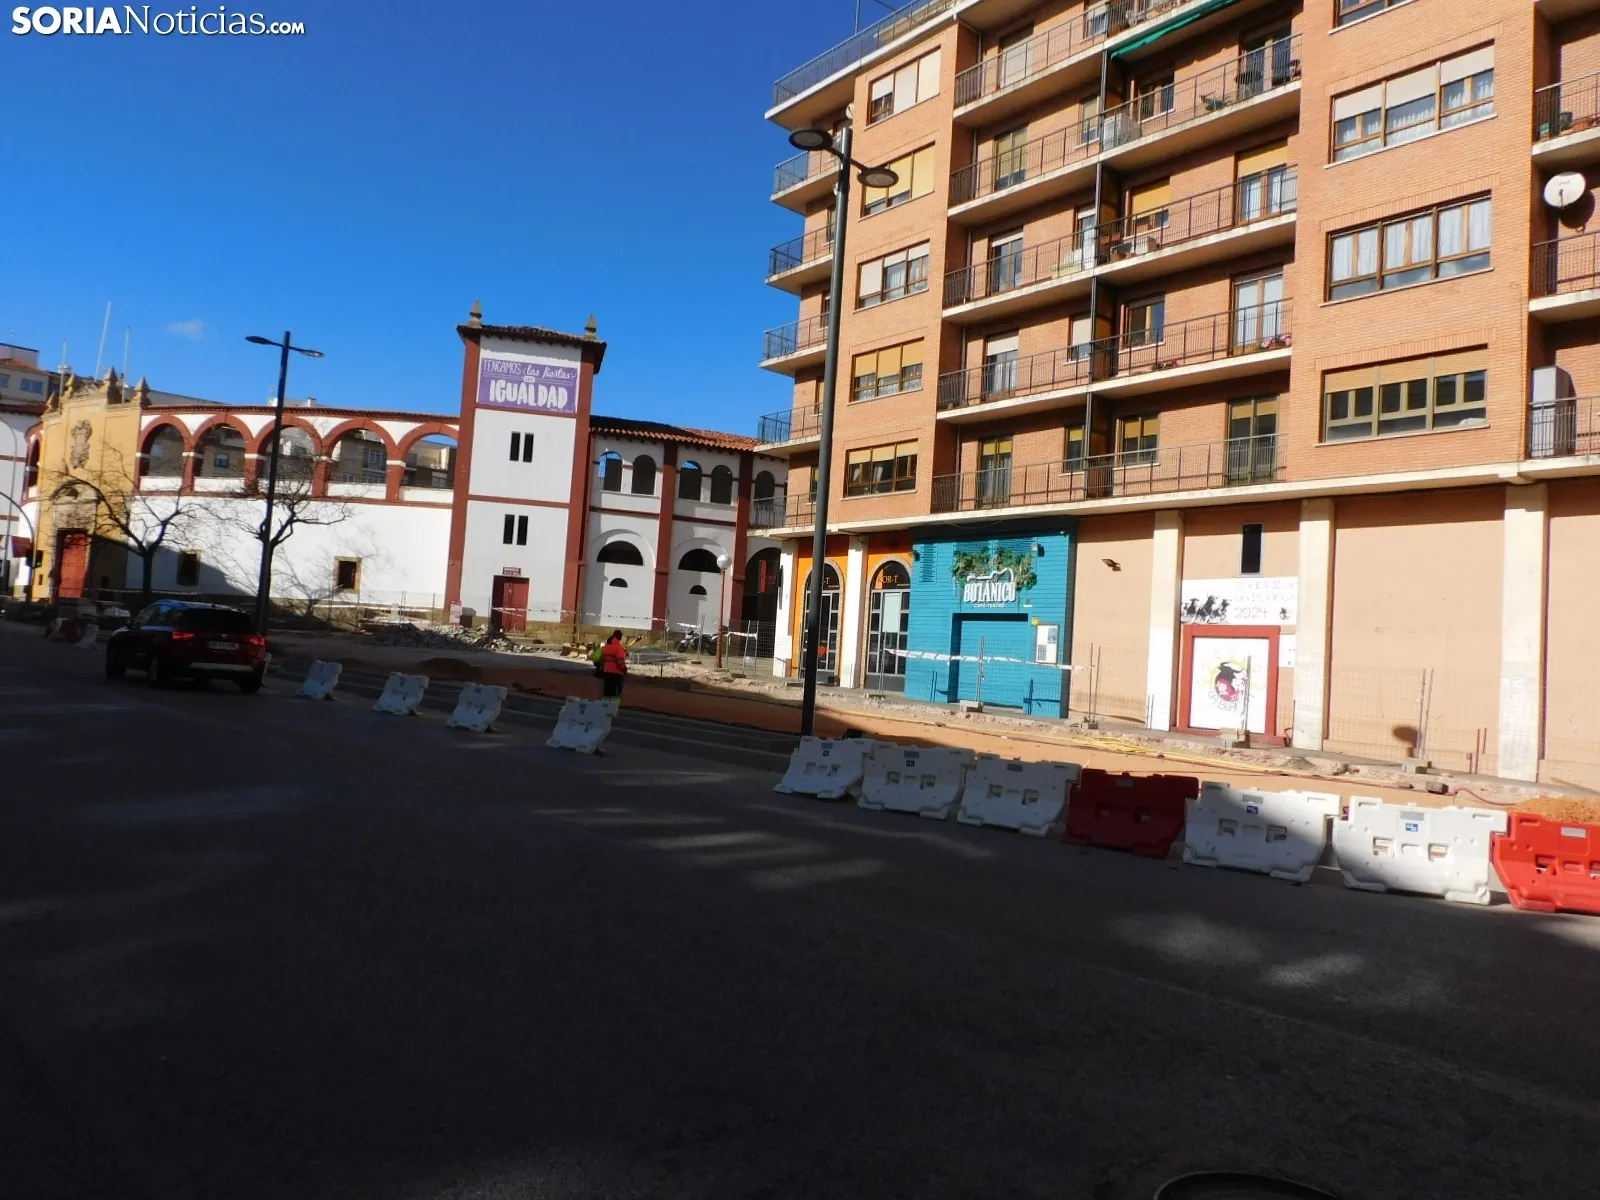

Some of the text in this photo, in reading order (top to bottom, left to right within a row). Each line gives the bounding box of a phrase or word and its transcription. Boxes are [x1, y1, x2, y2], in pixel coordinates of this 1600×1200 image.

[483, 360, 522, 375] TENGAMOS
[489, 379, 568, 408] IGUALDAD
[964, 580, 1015, 602] BOTÁNICO
[1234, 607, 1267, 618] 2024
